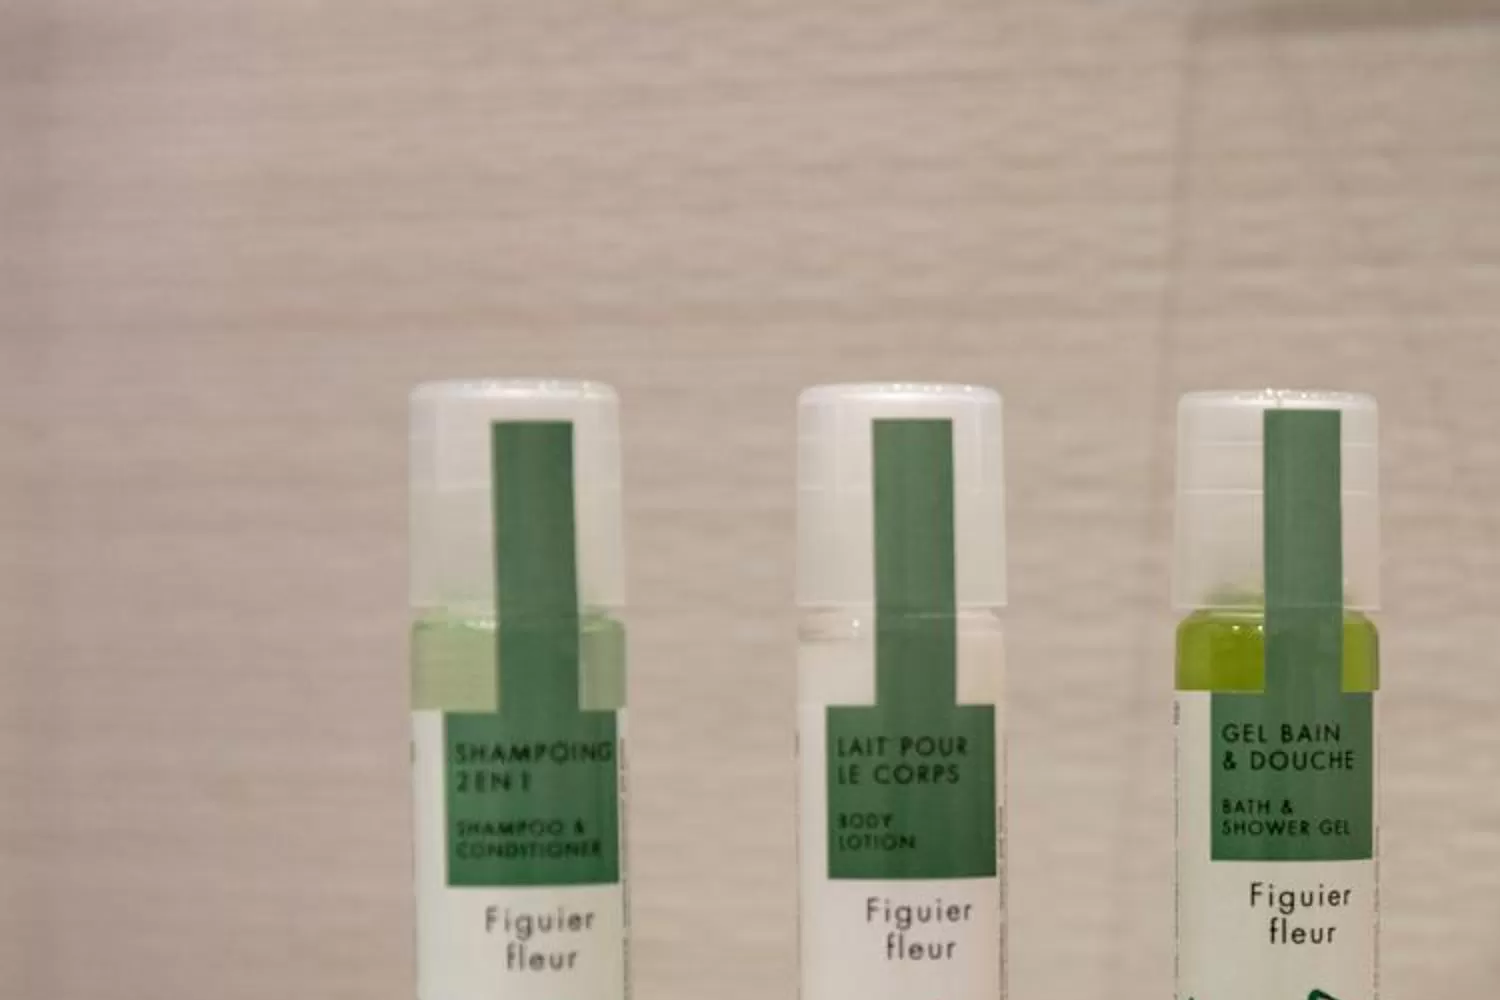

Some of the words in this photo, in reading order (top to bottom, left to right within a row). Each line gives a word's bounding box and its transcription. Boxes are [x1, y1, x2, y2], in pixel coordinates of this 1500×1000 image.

[1222, 724, 1267, 743] GEL
[1280, 724, 1340, 743] BAIN
[455, 742, 612, 763] SHAMPOING
[838, 736, 887, 757] LAIT
[901, 736, 967, 757] POUR
[1223, 751, 1237, 770] &
[1251, 750, 1354, 771] DOUCHE
[838, 764, 860, 784] LE
[873, 764, 960, 784] CORPS
[1222, 800, 1271, 814] BATH
[1281, 800, 1293, 814] &
[456, 819, 564, 837] SHAMPOO
[838, 813, 893, 829] BODY
[1221, 820, 1310, 836] SHOWER
[1319, 820, 1351, 836] GEL
[838, 834, 917, 851] LOTION
[1250, 882, 1352, 915] Figuier
[485, 905, 594, 941] Figuier
[866, 897, 972, 930] Figuier
[1270, 917, 1336, 945] fleur
[506, 942, 576, 971] fleur
[886, 932, 956, 961] fleur
